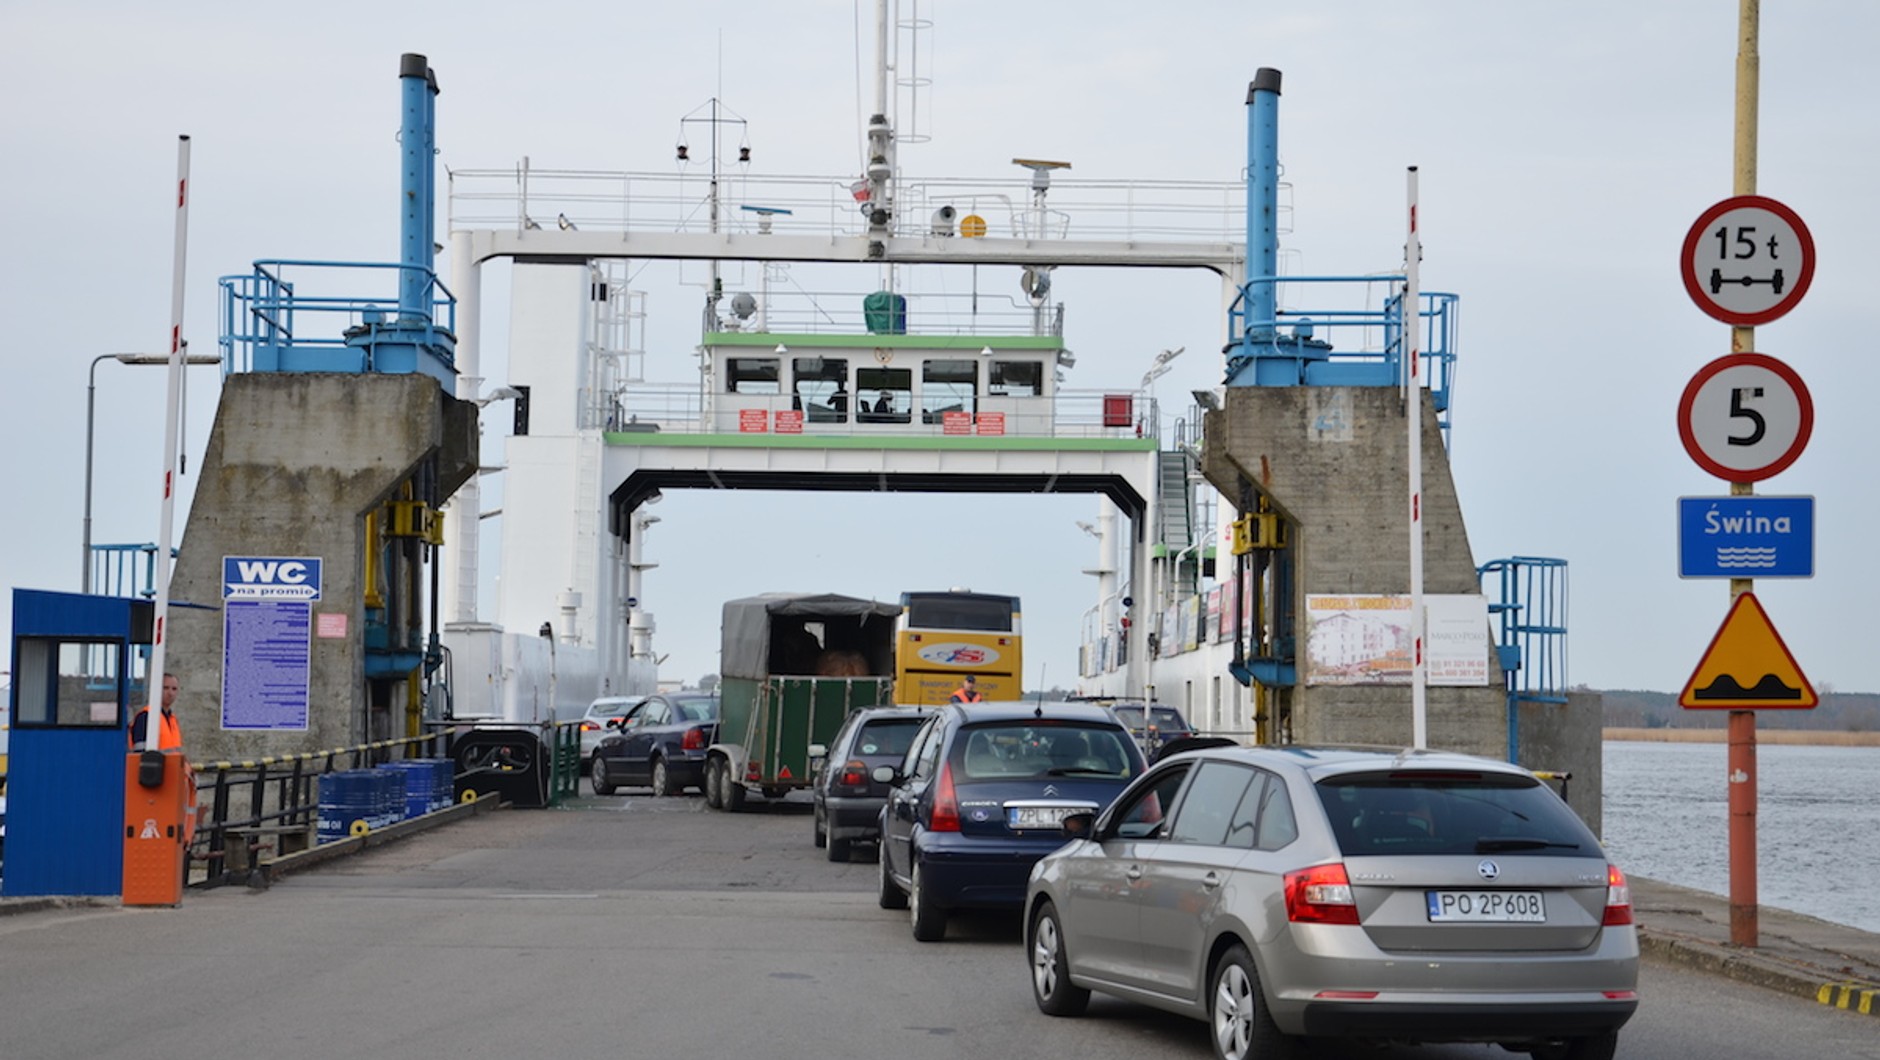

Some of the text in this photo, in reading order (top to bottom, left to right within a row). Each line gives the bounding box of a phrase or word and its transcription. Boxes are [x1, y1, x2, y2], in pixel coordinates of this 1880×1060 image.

[1715, 226, 1779, 260] 15 t
[1727, 387, 1767, 447] 5
[1704, 503, 1792, 535] Świna
[237, 561, 307, 584] WC
[1018, 809, 1043, 823] ZPL
[1442, 894, 1540, 915] PO 2P608
